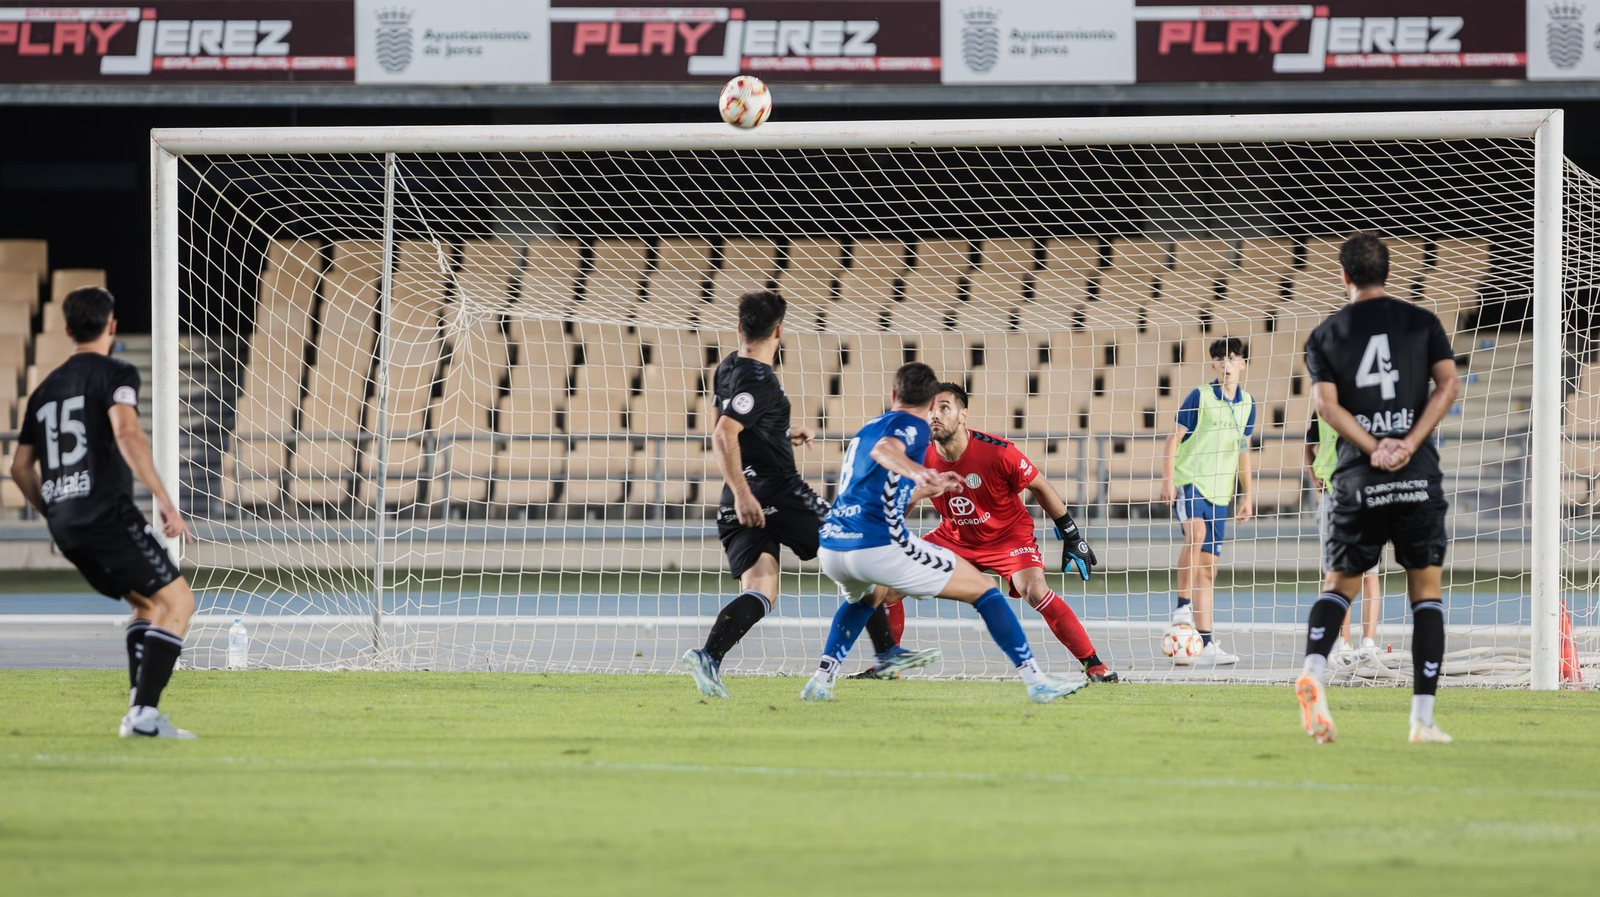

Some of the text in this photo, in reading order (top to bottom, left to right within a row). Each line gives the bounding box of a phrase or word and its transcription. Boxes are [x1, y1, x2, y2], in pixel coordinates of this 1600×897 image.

[573, 22, 716, 56] PLAY
[1158, 20, 1299, 54] PLAY
[1355, 333, 1399, 400] 4
[36, 395, 88, 470] 15
[957, 511, 991, 526] GORDILLO
